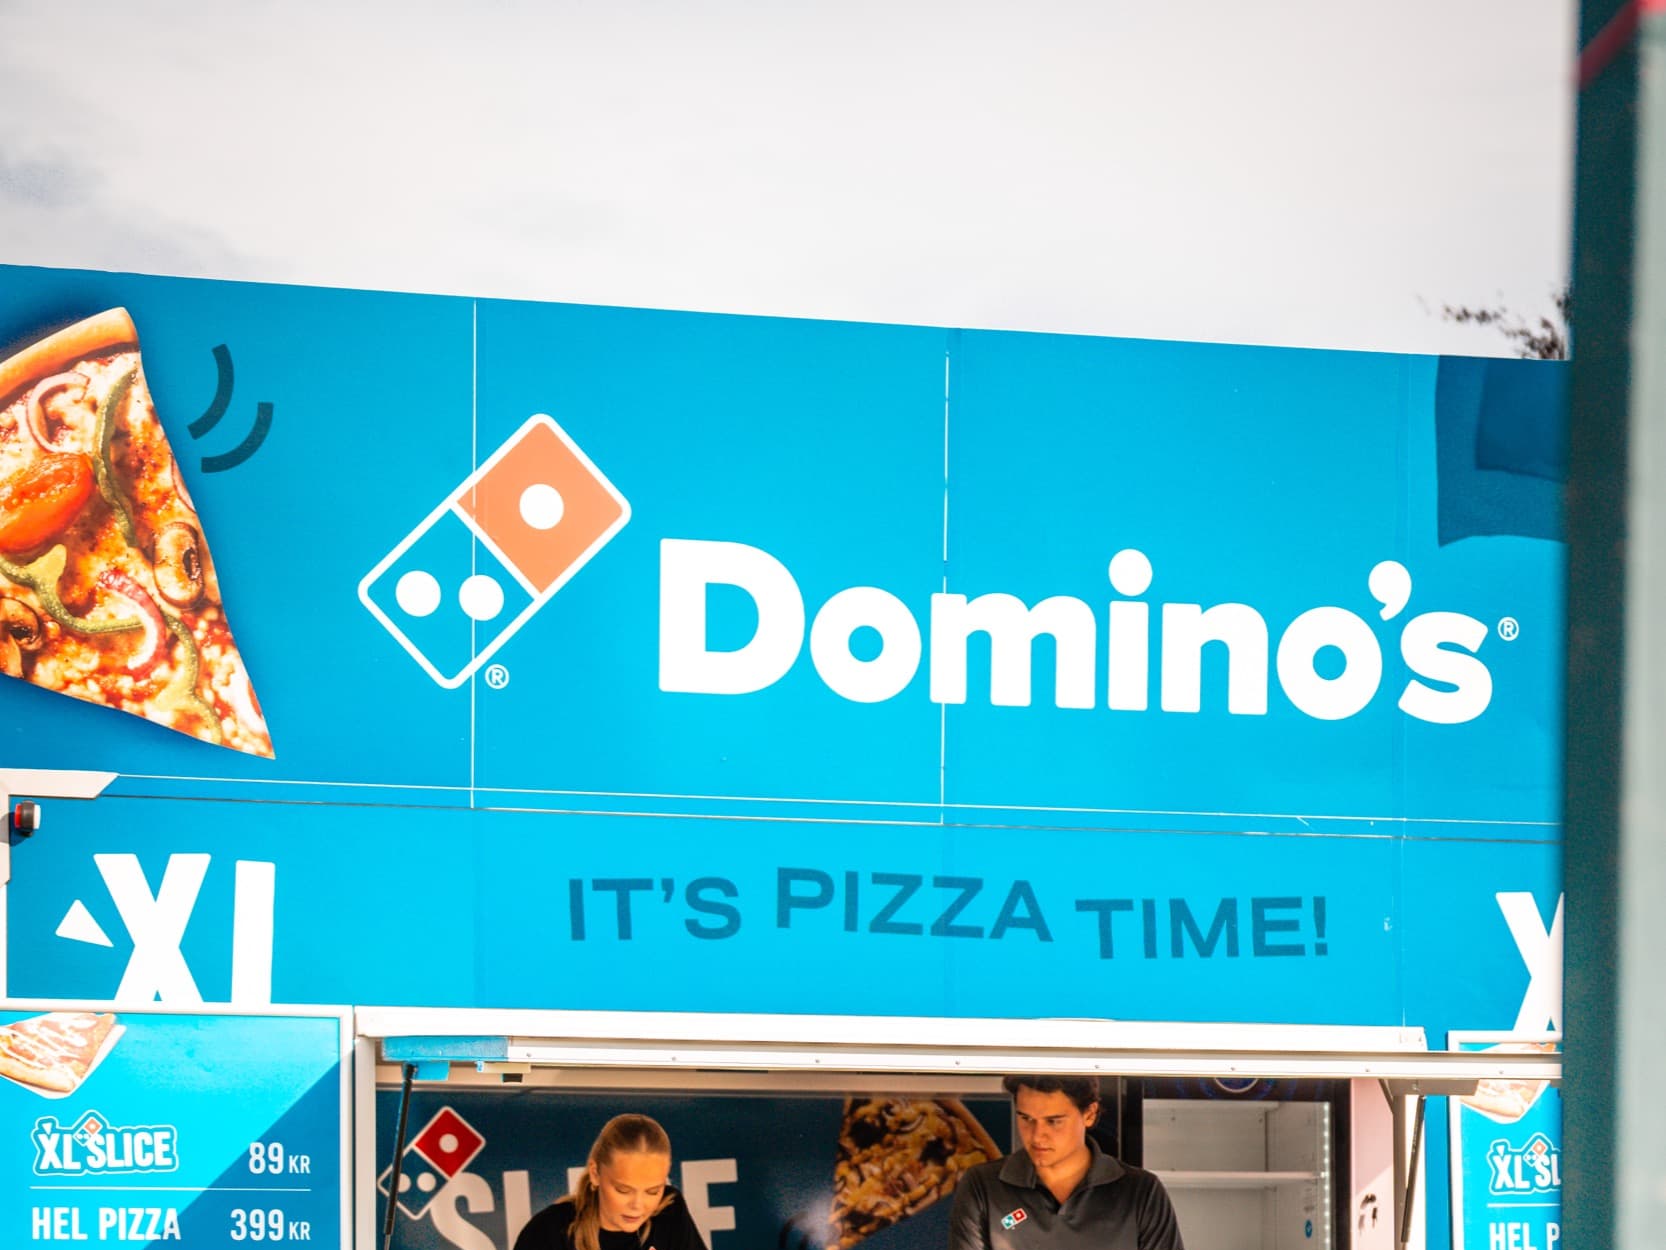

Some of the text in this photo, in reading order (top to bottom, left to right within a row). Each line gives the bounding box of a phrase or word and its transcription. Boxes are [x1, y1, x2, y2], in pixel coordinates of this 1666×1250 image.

[569, 866, 1330, 961] IT'S PIZZA TIME!
[37, 1122, 310, 1175] XL SLICE 89 KR
[31, 1206, 311, 1241] HEL PIZZA 399 KR
